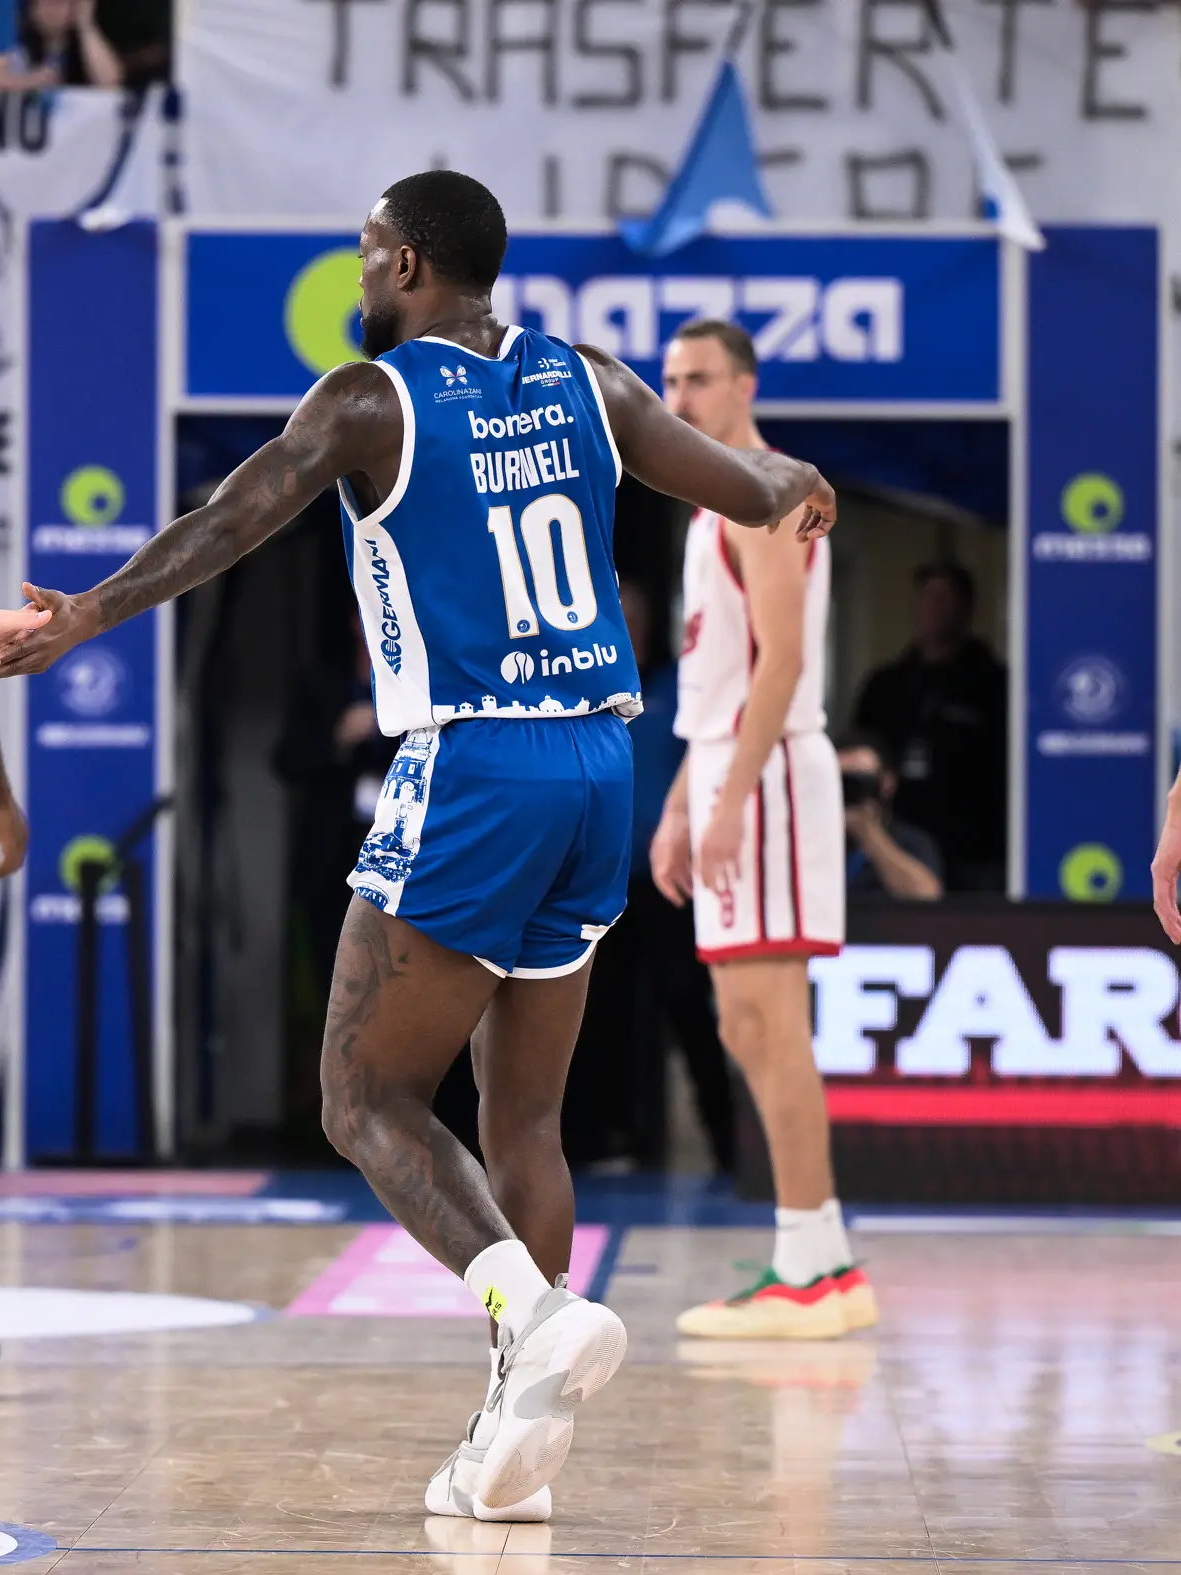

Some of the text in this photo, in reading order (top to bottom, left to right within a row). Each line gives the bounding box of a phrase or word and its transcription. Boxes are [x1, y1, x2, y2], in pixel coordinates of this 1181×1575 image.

[468, 403, 574, 439] bonera.
[470, 438, 579, 493] BURNELL
[487, 493, 598, 639] 10
[540, 643, 618, 677] inblu
[807, 944, 1181, 1078] FAR
[490, 1301, 503, 1319] RS
